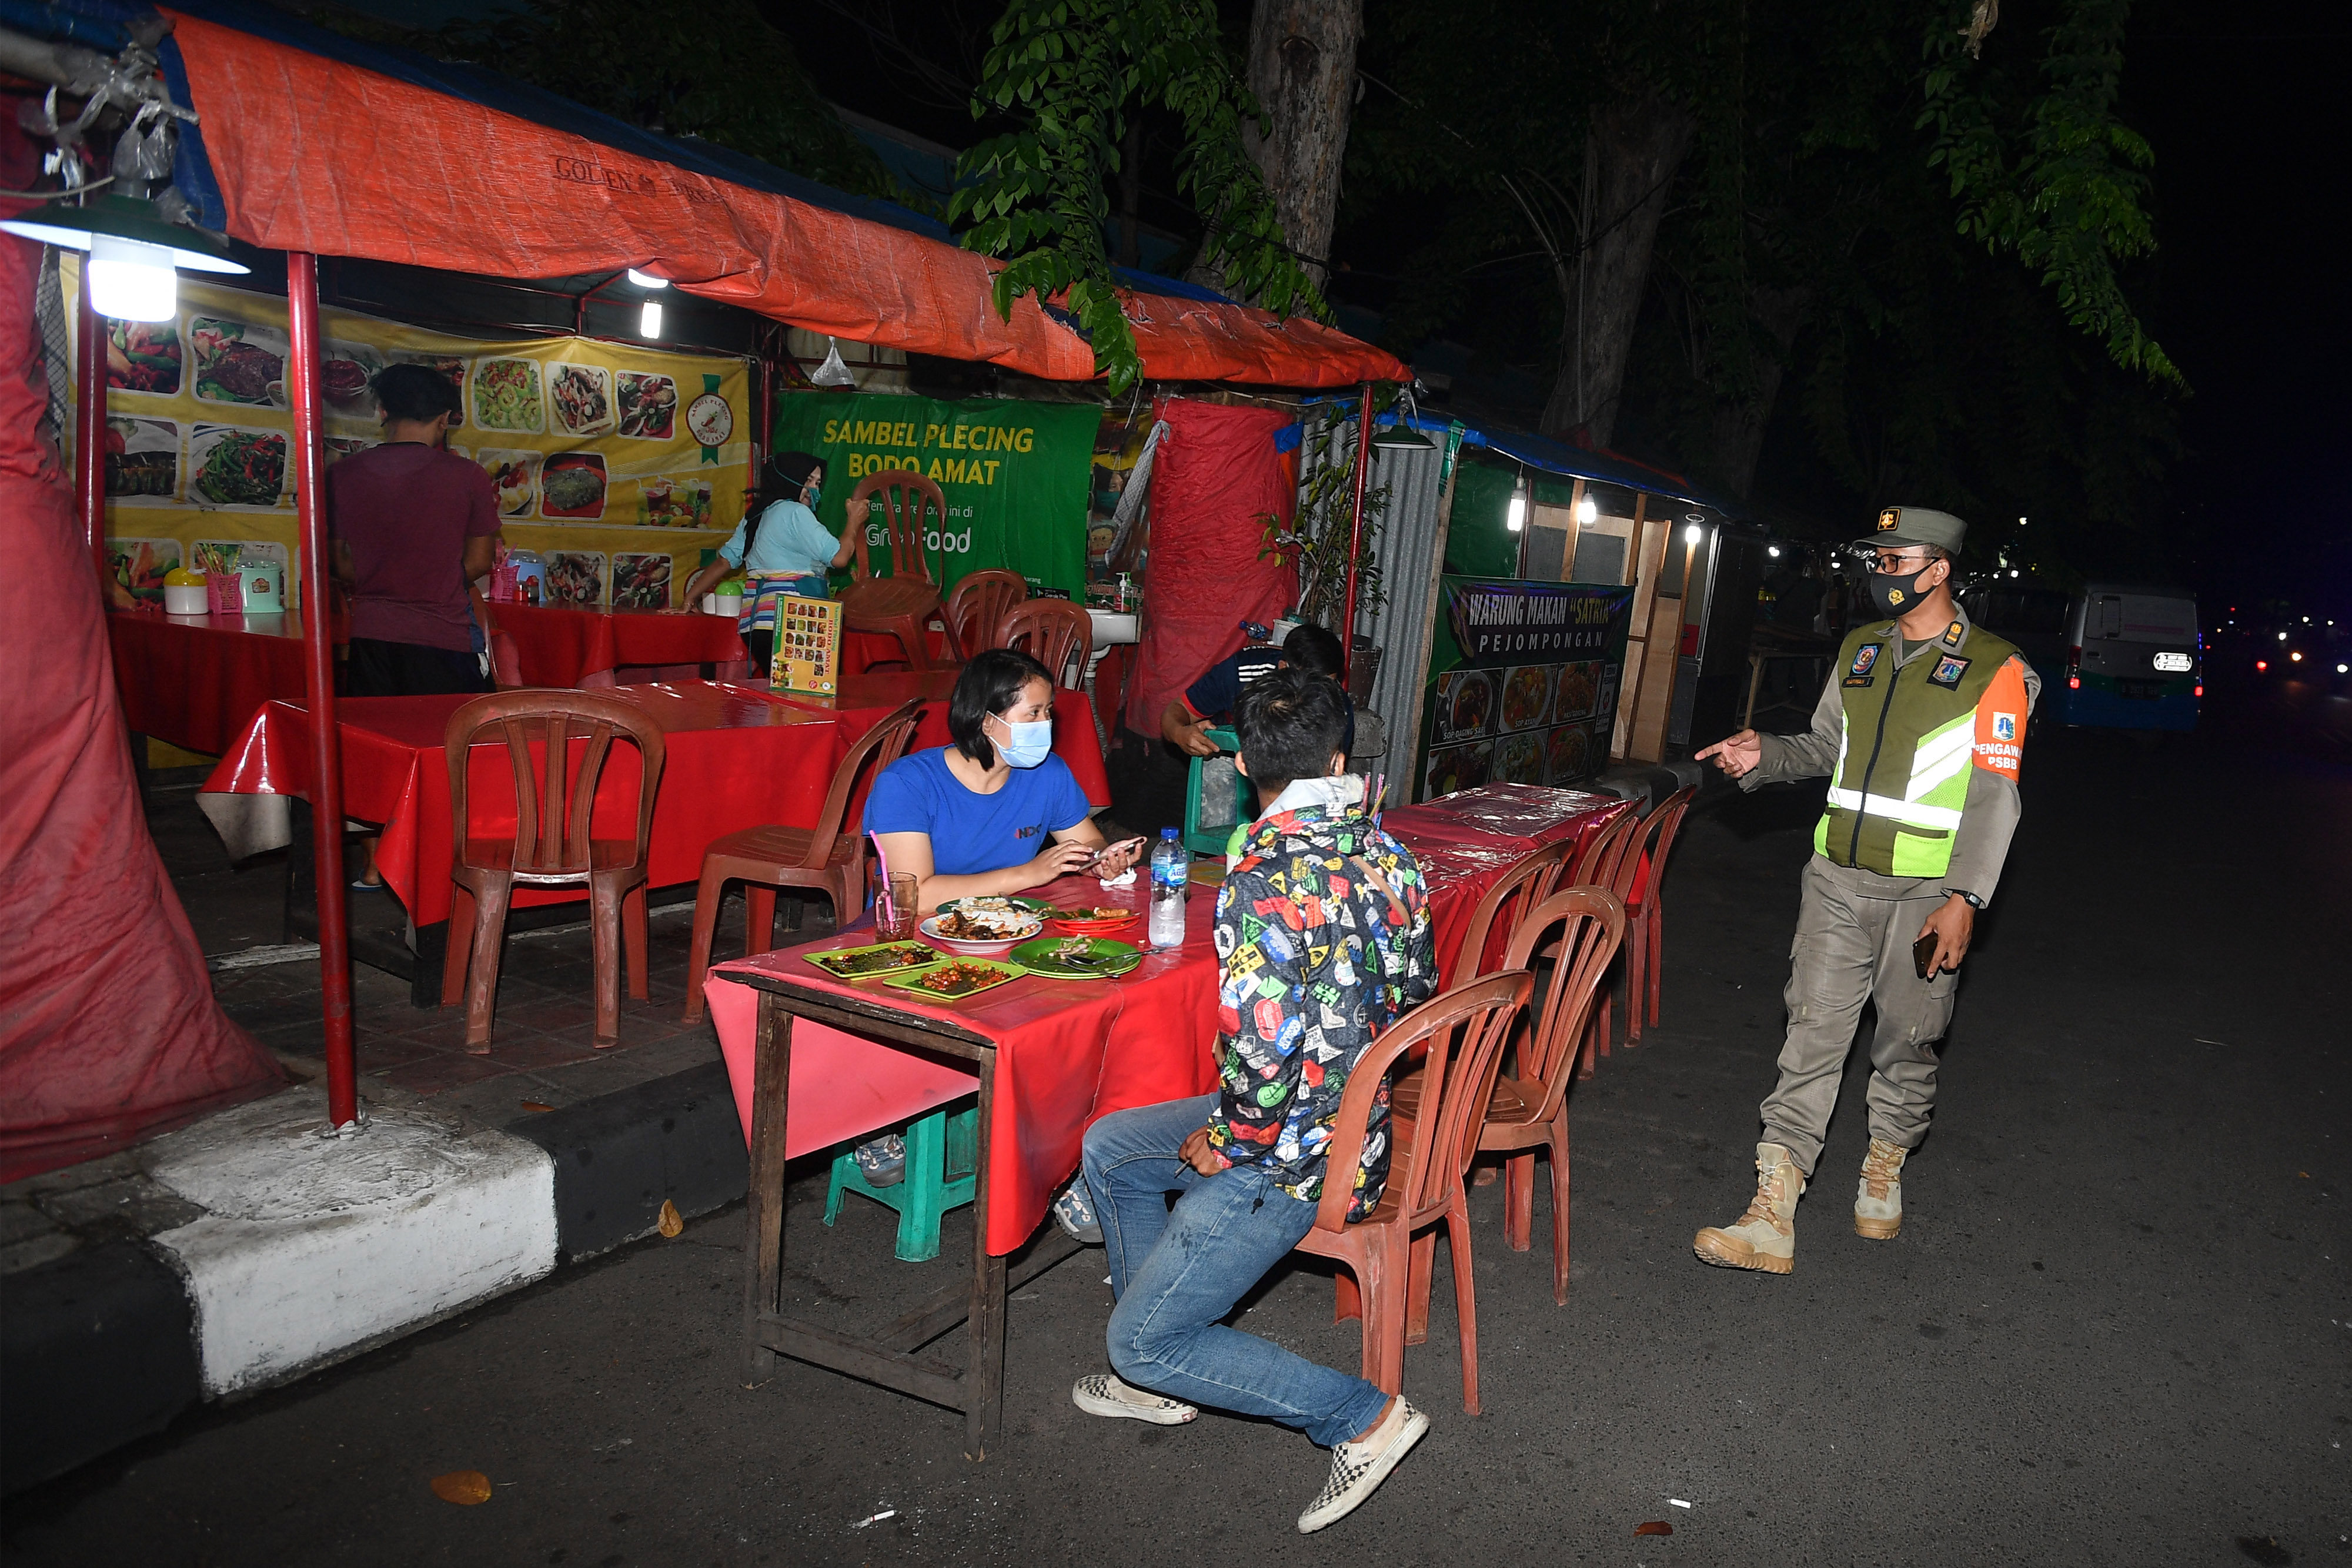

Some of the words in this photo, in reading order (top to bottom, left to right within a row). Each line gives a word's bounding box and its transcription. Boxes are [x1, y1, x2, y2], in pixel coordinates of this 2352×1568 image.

[823, 419, 917, 447] SAMBEL
[924, 424, 1033, 453] PLECING
[927, 457, 1000, 484] AMAT
[949, 505, 960, 517] ini
[963, 506, 973, 518] di
[1469, 594, 1525, 626] WARUNG
[1526, 596, 1568, 626] MAKAN
[1479, 631, 1602, 653] PEJOMPONGAN
[1515, 719, 1524, 728] SOP
[1443, 730, 1455, 740] SOP
[1987, 756, 2017, 770] PSBB
